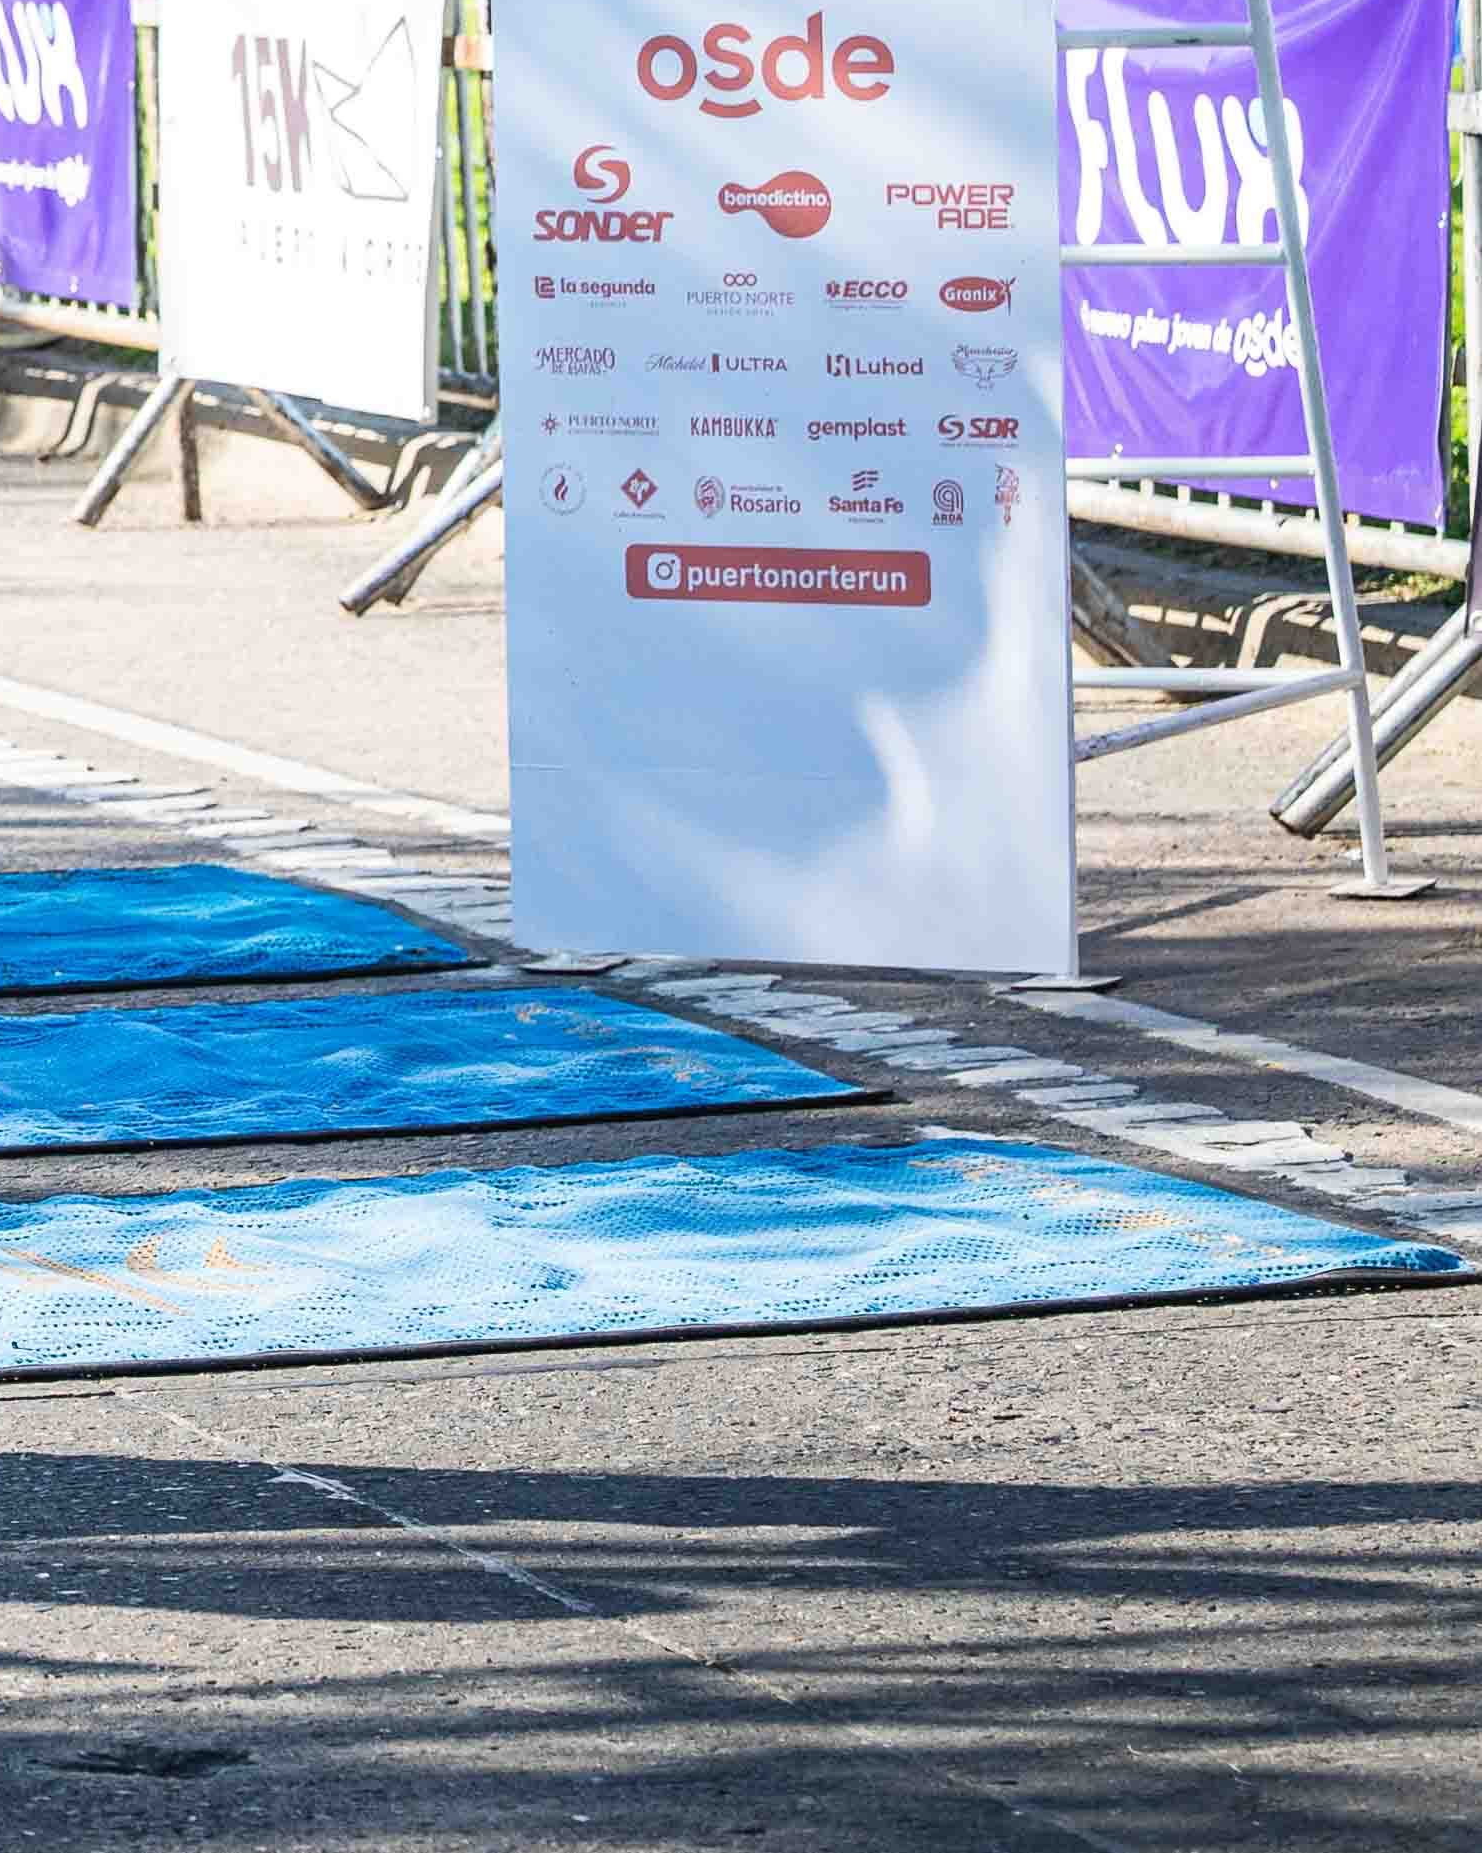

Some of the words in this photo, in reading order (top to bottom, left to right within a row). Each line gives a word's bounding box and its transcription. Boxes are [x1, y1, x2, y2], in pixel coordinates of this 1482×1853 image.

[636, 11, 895, 118] osde
[886, 183, 1016, 206] POWER
[560, 277, 577, 296] la
[581, 277, 656, 299] segunda
[686, 291, 741, 306] PUERTO
[745, 291, 795, 306] NORTE
[842, 280, 908, 299] ECCO
[535, 347, 616, 370] MERCADO
[725, 356, 788, 373] ULTRA
[855, 357, 924, 376] Luhod
[690, 416, 776, 437] KAMBUKKA
[807, 416, 908, 442] gemplast
[968, 417, 1019, 439] SDR
[730, 494, 802, 514] Rosario
[828, 496, 881, 515] Santa
[884, 497, 905, 515] Fe
[687, 558, 907, 594] puertonorterun
